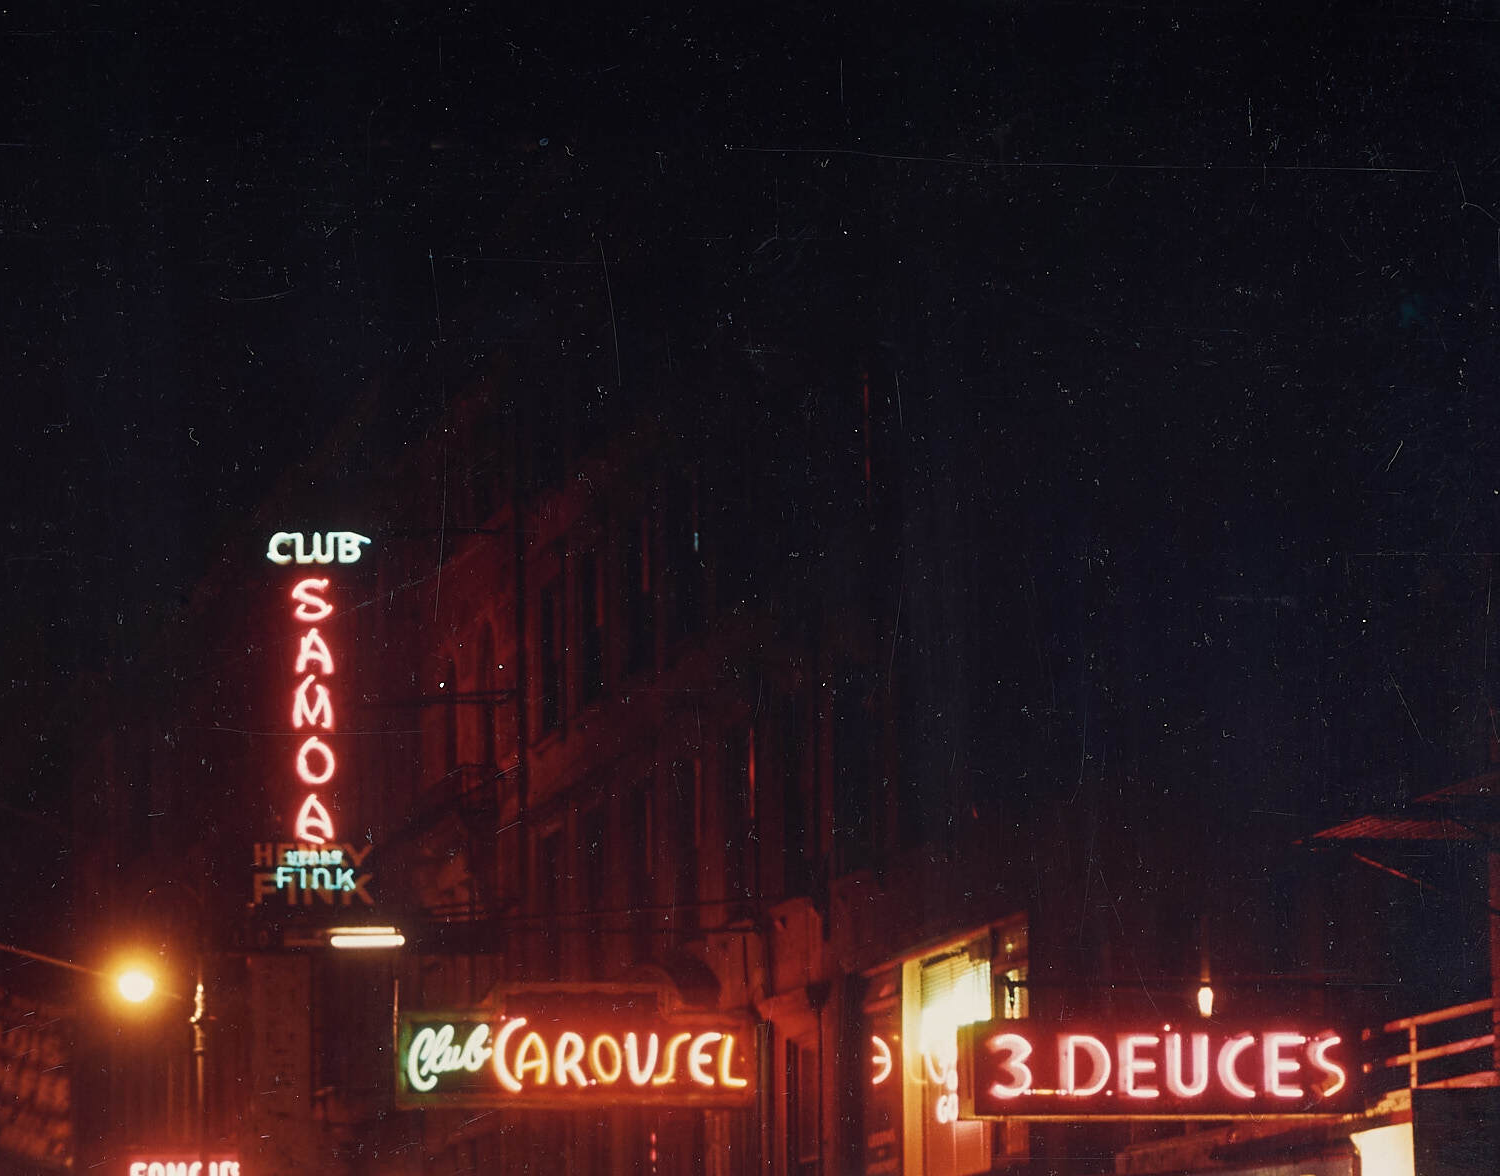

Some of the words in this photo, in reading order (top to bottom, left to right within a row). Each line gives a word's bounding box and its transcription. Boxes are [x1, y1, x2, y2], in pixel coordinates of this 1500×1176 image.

[267, 531, 371, 564] CLUB
[291, 578, 336, 845] SAMOA
[407, 1024, 492, 1093] Club
[493, 1016, 748, 1094] CAROUSEL
[988, 1033, 1033, 1099] 3
[1058, 1032, 1346, 1098] DEUCES
